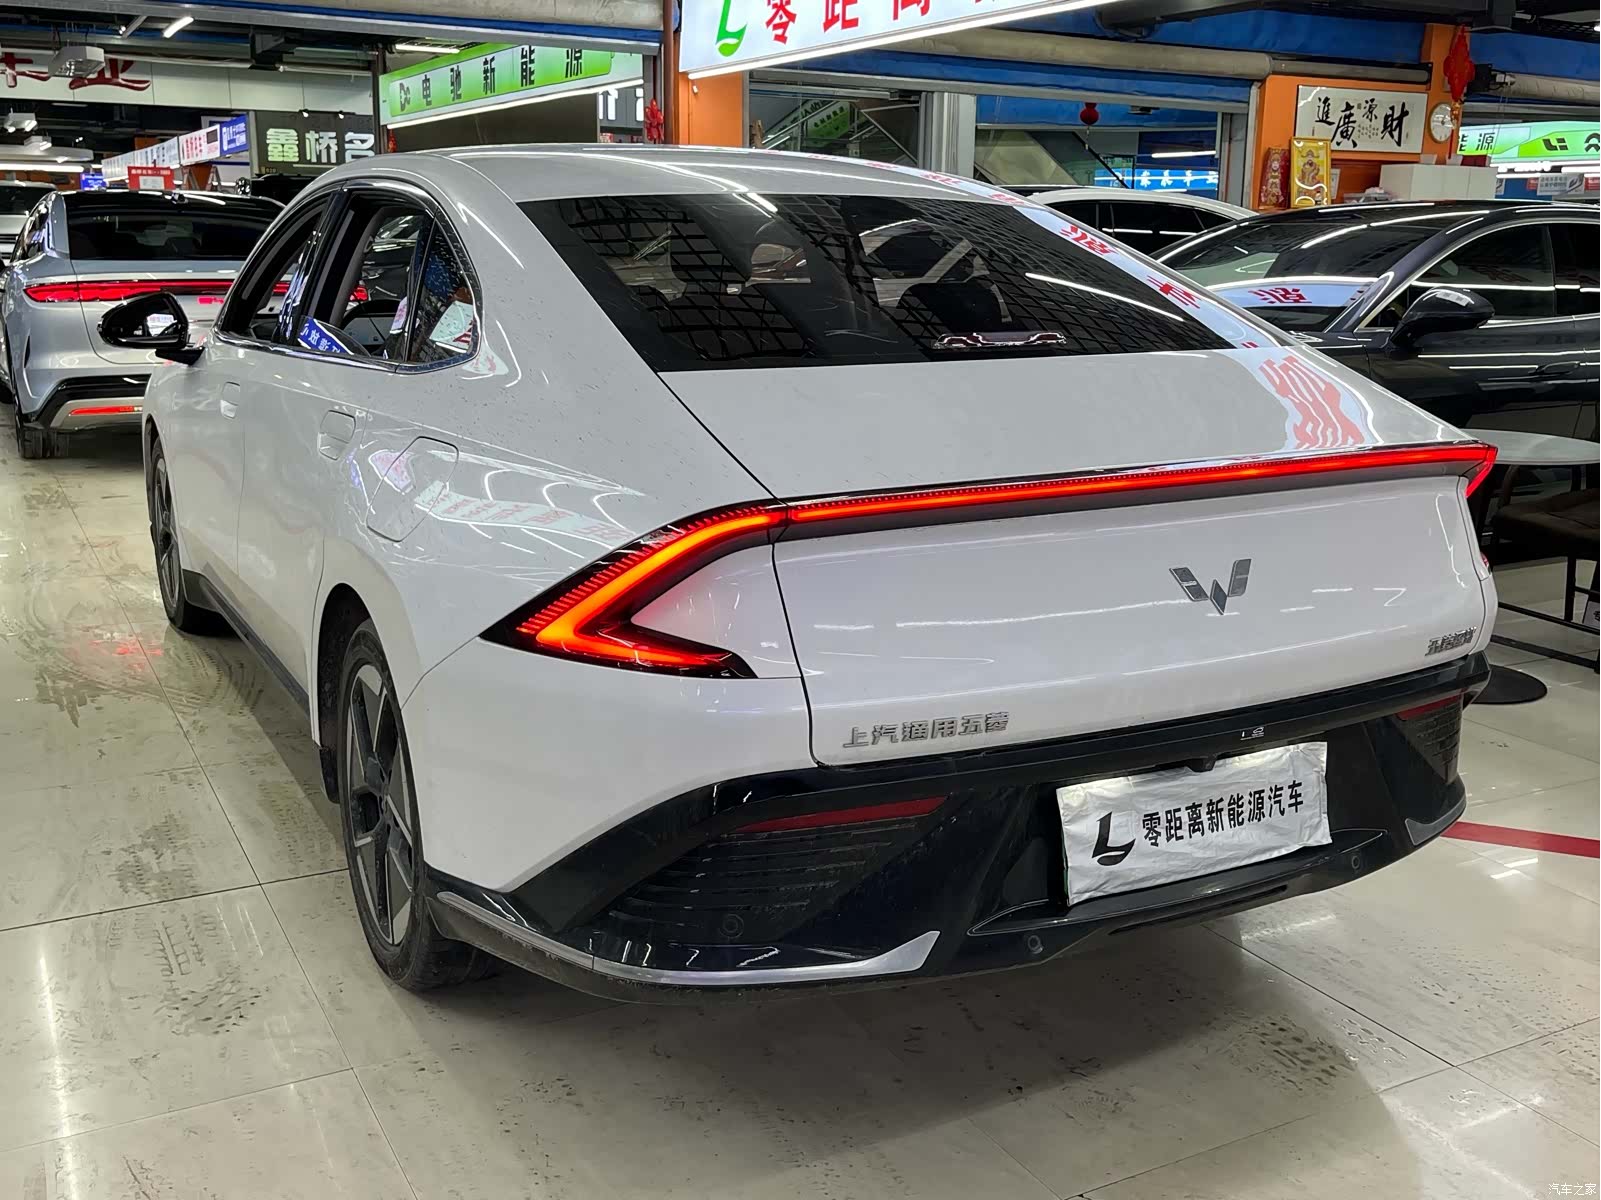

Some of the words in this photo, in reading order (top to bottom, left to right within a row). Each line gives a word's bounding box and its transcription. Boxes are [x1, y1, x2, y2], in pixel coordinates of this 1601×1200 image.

[842, 711, 1009, 748] 上汽通用五菱
[1142, 780, 1304, 847] 零距离新能源汽车
